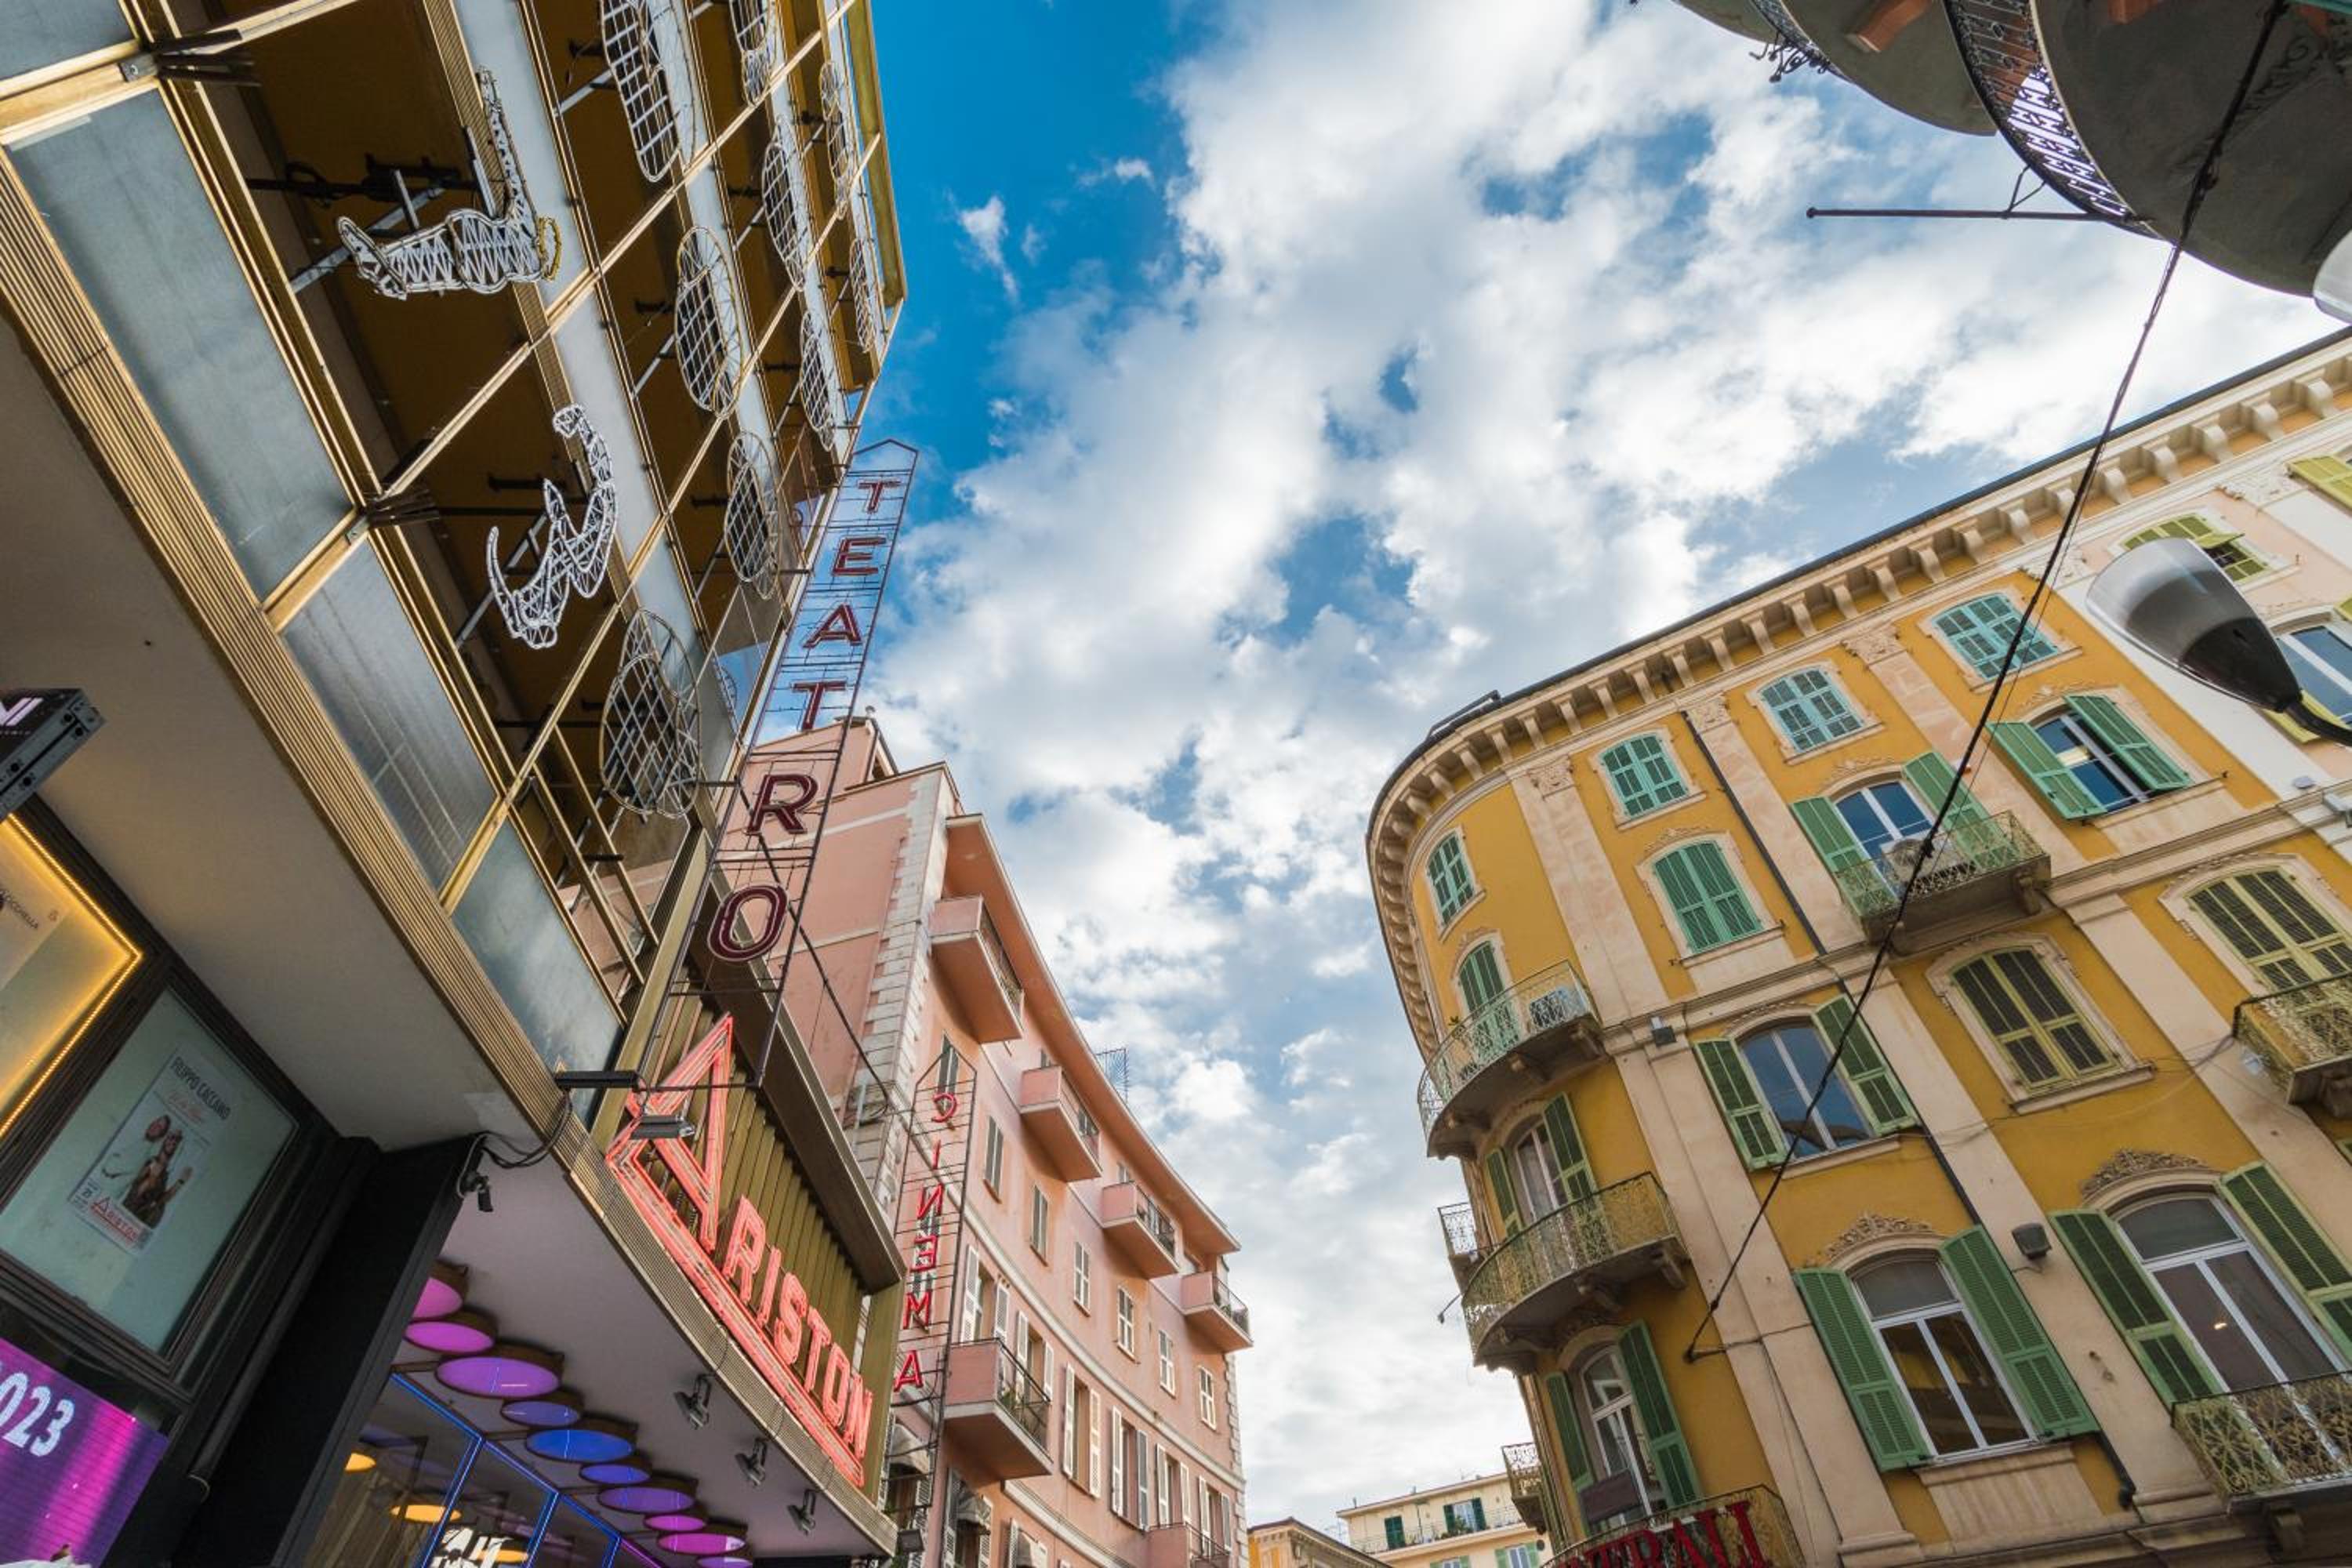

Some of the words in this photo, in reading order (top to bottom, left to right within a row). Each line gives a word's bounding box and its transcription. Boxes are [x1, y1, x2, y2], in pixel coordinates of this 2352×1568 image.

[708, 479, 903, 962] TEATRO
[0, 1363, 74, 1457] 023
[606, 1012, 873, 1486] ARISTON
